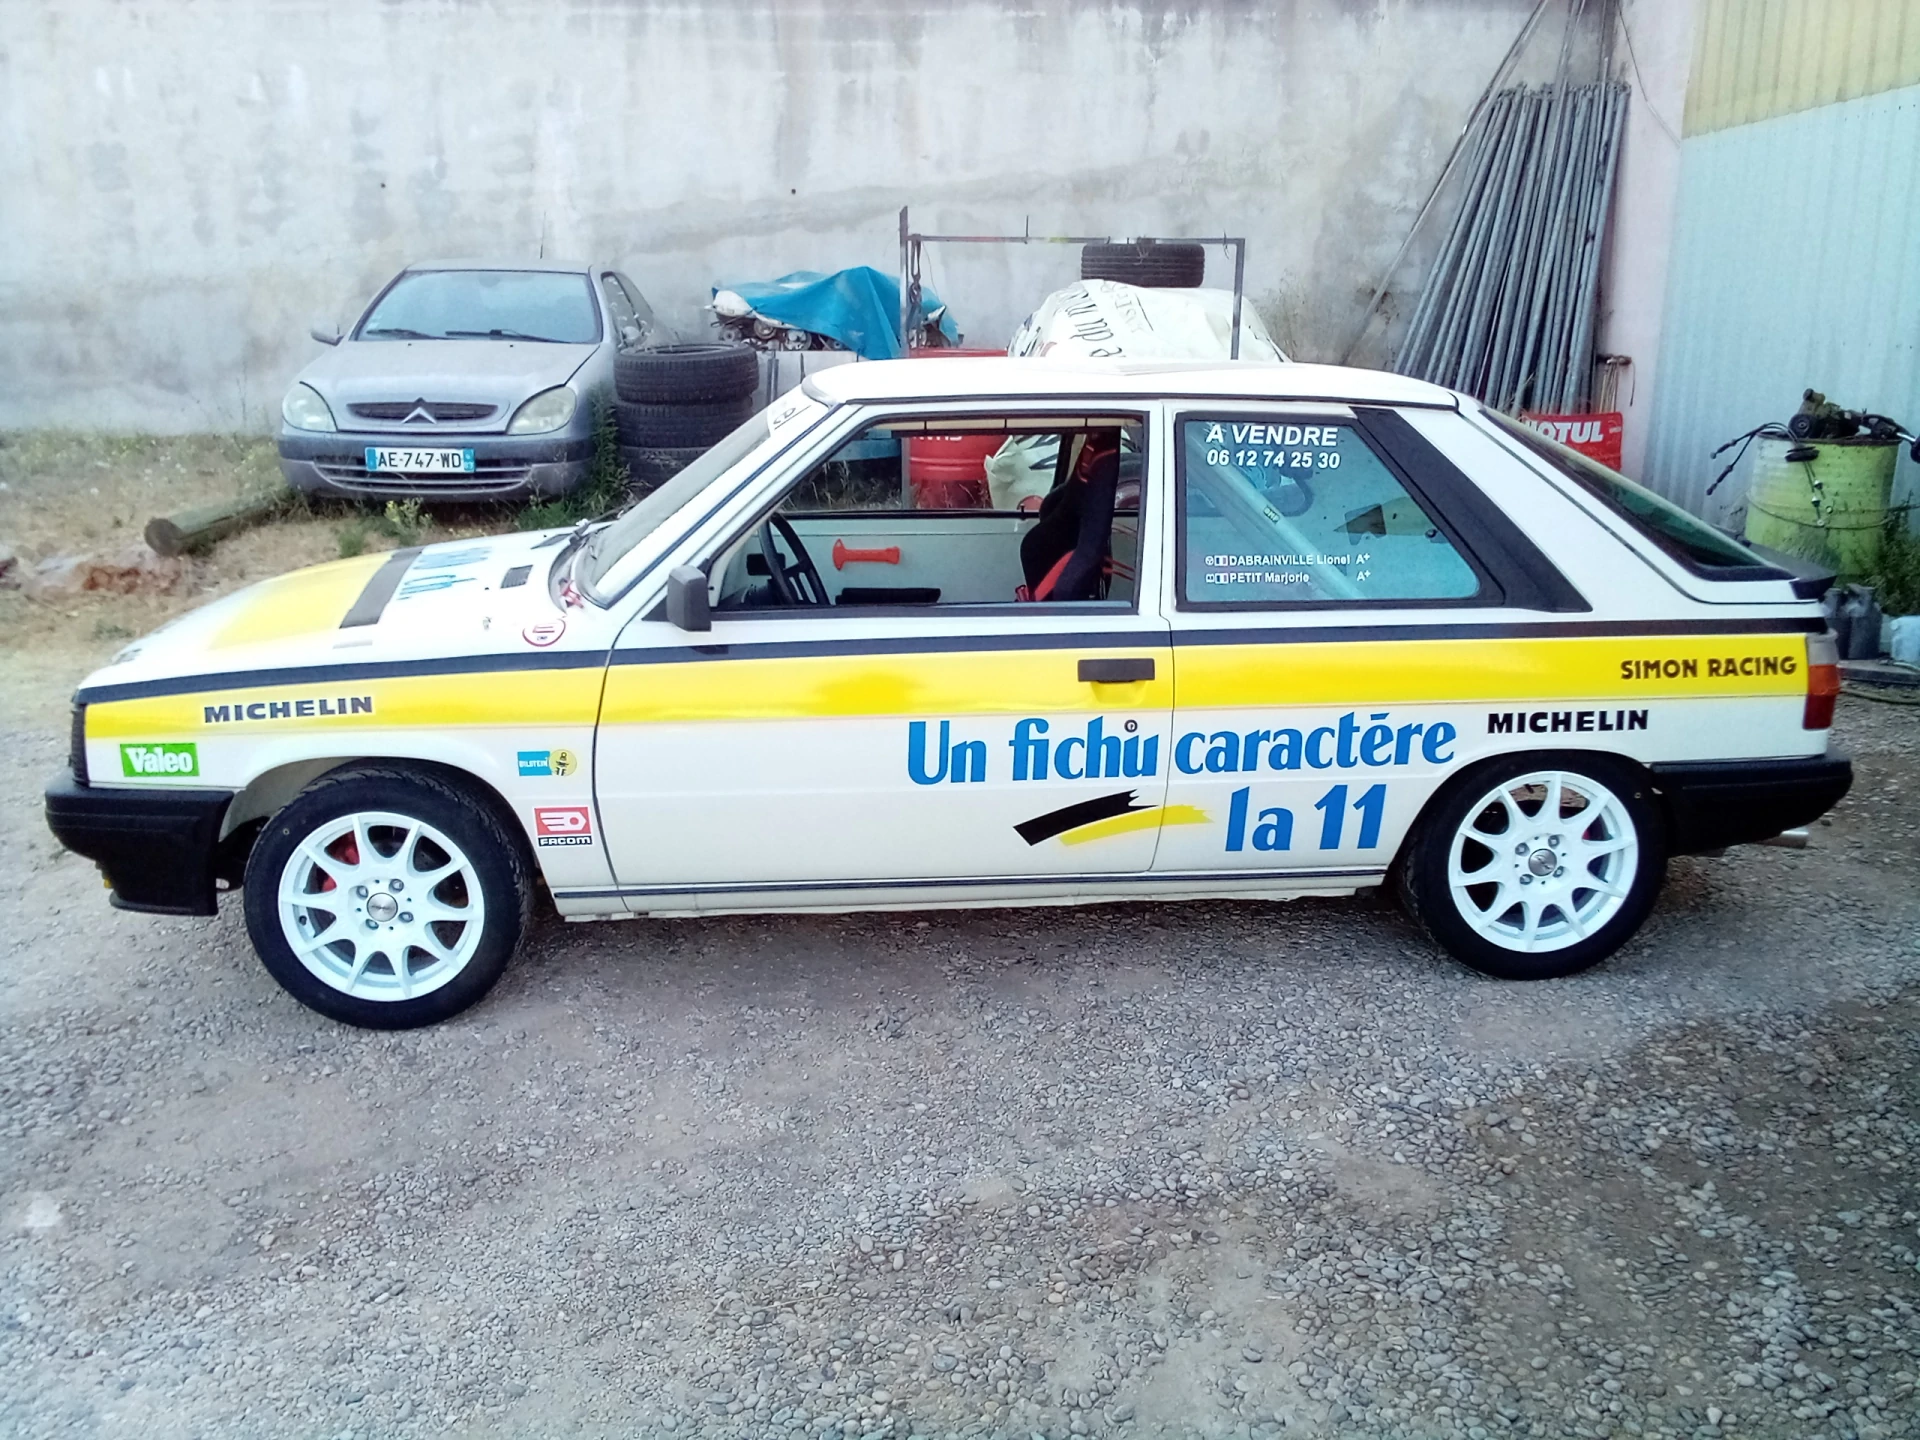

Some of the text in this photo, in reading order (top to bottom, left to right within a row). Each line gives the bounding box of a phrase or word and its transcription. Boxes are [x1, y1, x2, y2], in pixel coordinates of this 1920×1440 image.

[1206, 424, 1338, 446] A VENDRE
[378, 452, 462, 468] AE-747-WD
[1206, 449, 1341, 469] 06 12 74 25 30
[1229, 554, 1313, 566] DABRAINVILLE
[1229, 572, 1262, 584] PETIT
[1264, 571, 1310, 585] Marjorie
[1621, 656, 1797, 679] SIMON RACING
[204, 697, 373, 723] MICHELIN
[1487, 709, 1649, 734] MICHELIN
[125, 747, 194, 773] Valeo
[908, 720, 987, 785] Un
[1009, 716, 1159, 780] fichu
[1225, 784, 1387, 851] la 11
[540, 836, 591, 846] FACOM
